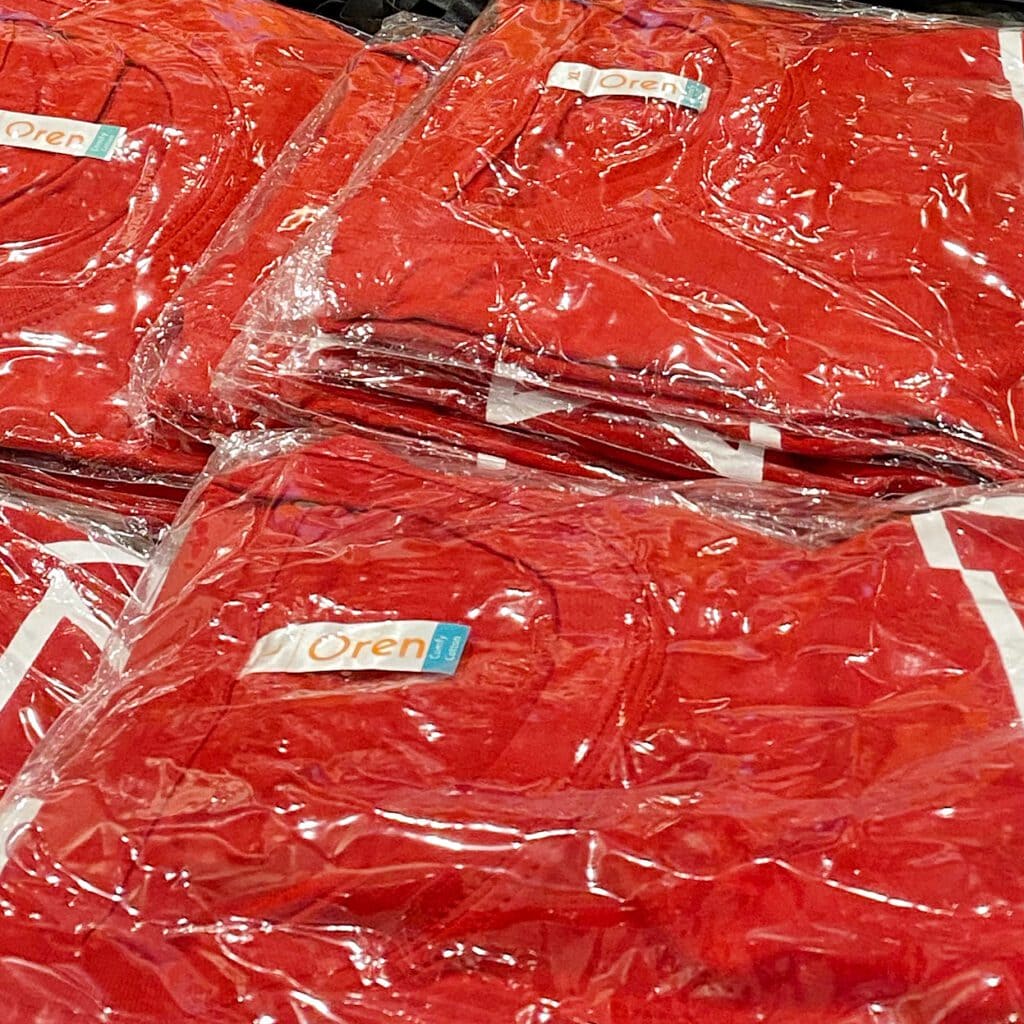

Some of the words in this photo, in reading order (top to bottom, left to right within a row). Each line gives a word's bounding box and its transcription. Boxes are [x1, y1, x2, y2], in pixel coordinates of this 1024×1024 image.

[600, 73, 678, 95] Oren
[5, 120, 85, 148] Oren
[308, 634, 426, 662] Oren
